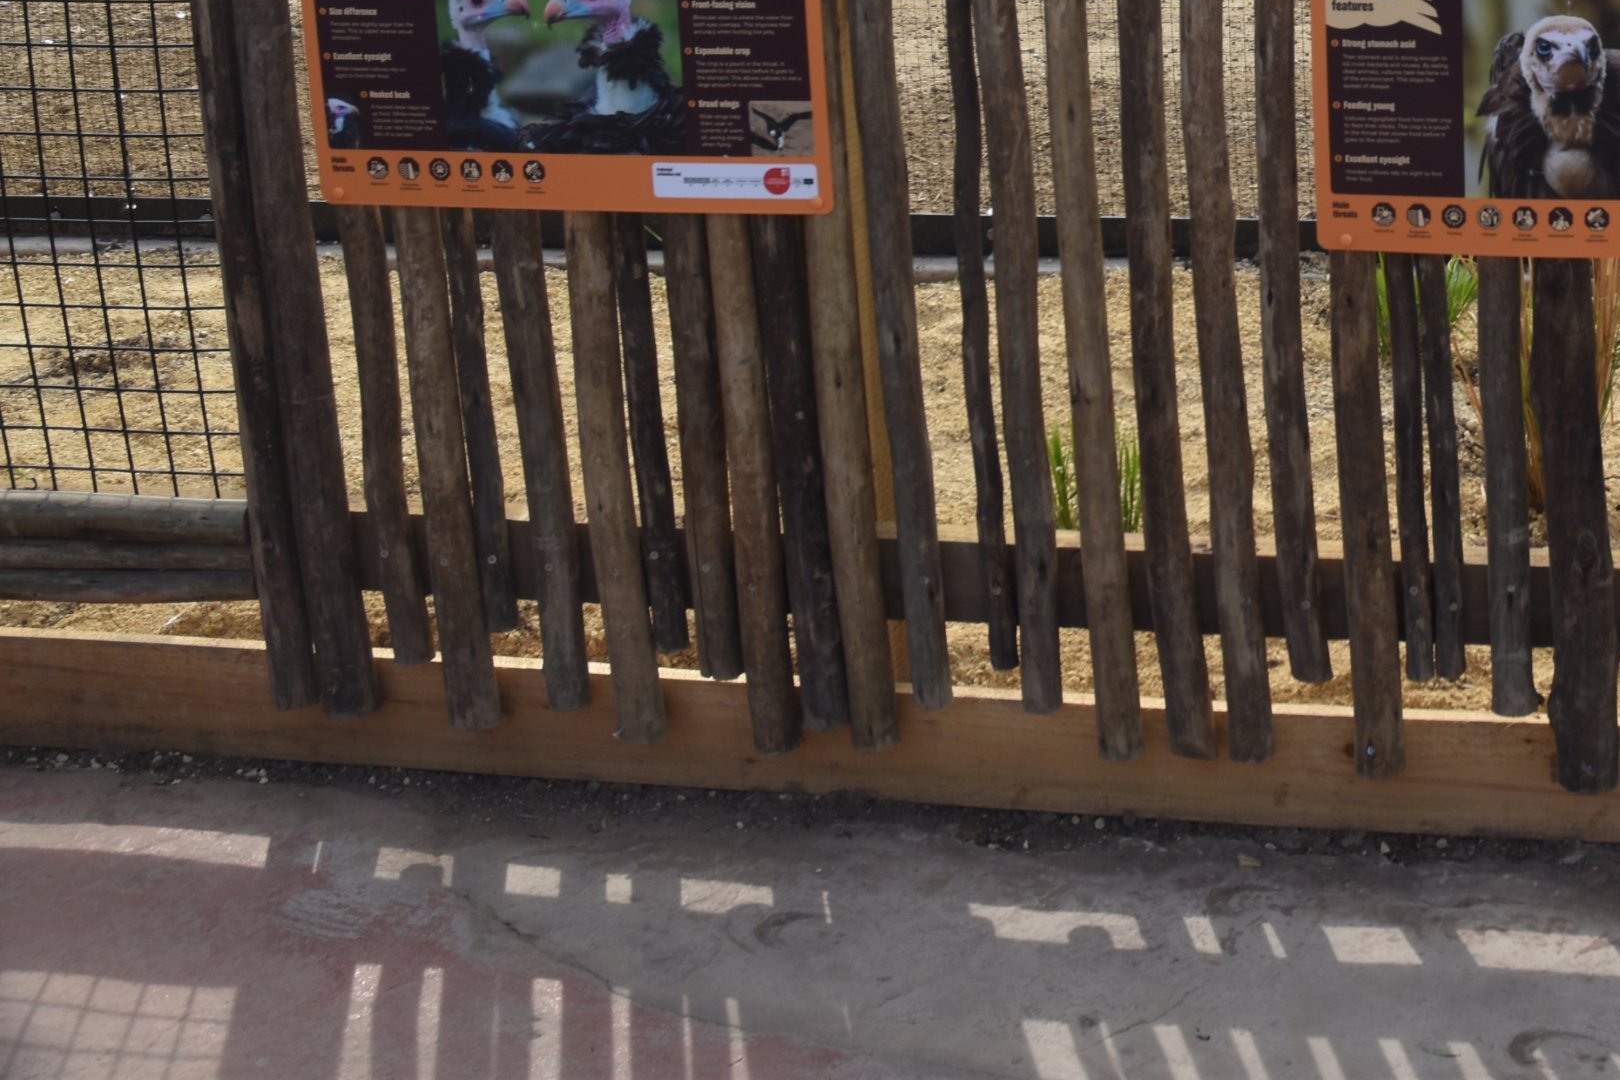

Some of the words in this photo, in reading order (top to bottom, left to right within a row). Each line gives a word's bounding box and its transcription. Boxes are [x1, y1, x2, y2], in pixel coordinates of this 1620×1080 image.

[1331, 0, 1374, 12] features
[1341, 38, 1366, 48] Strong
[1366, 39, 1398, 47] stomach
[1399, 39, 1416, 47] acid
[363, 52, 392, 61] eyesight
[1343, 101, 1372, 111] Feeding
[1372, 103, 1396, 111] young
[1344, 154, 1378, 164] Excellent
[1378, 155, 1411, 165] eyesight
